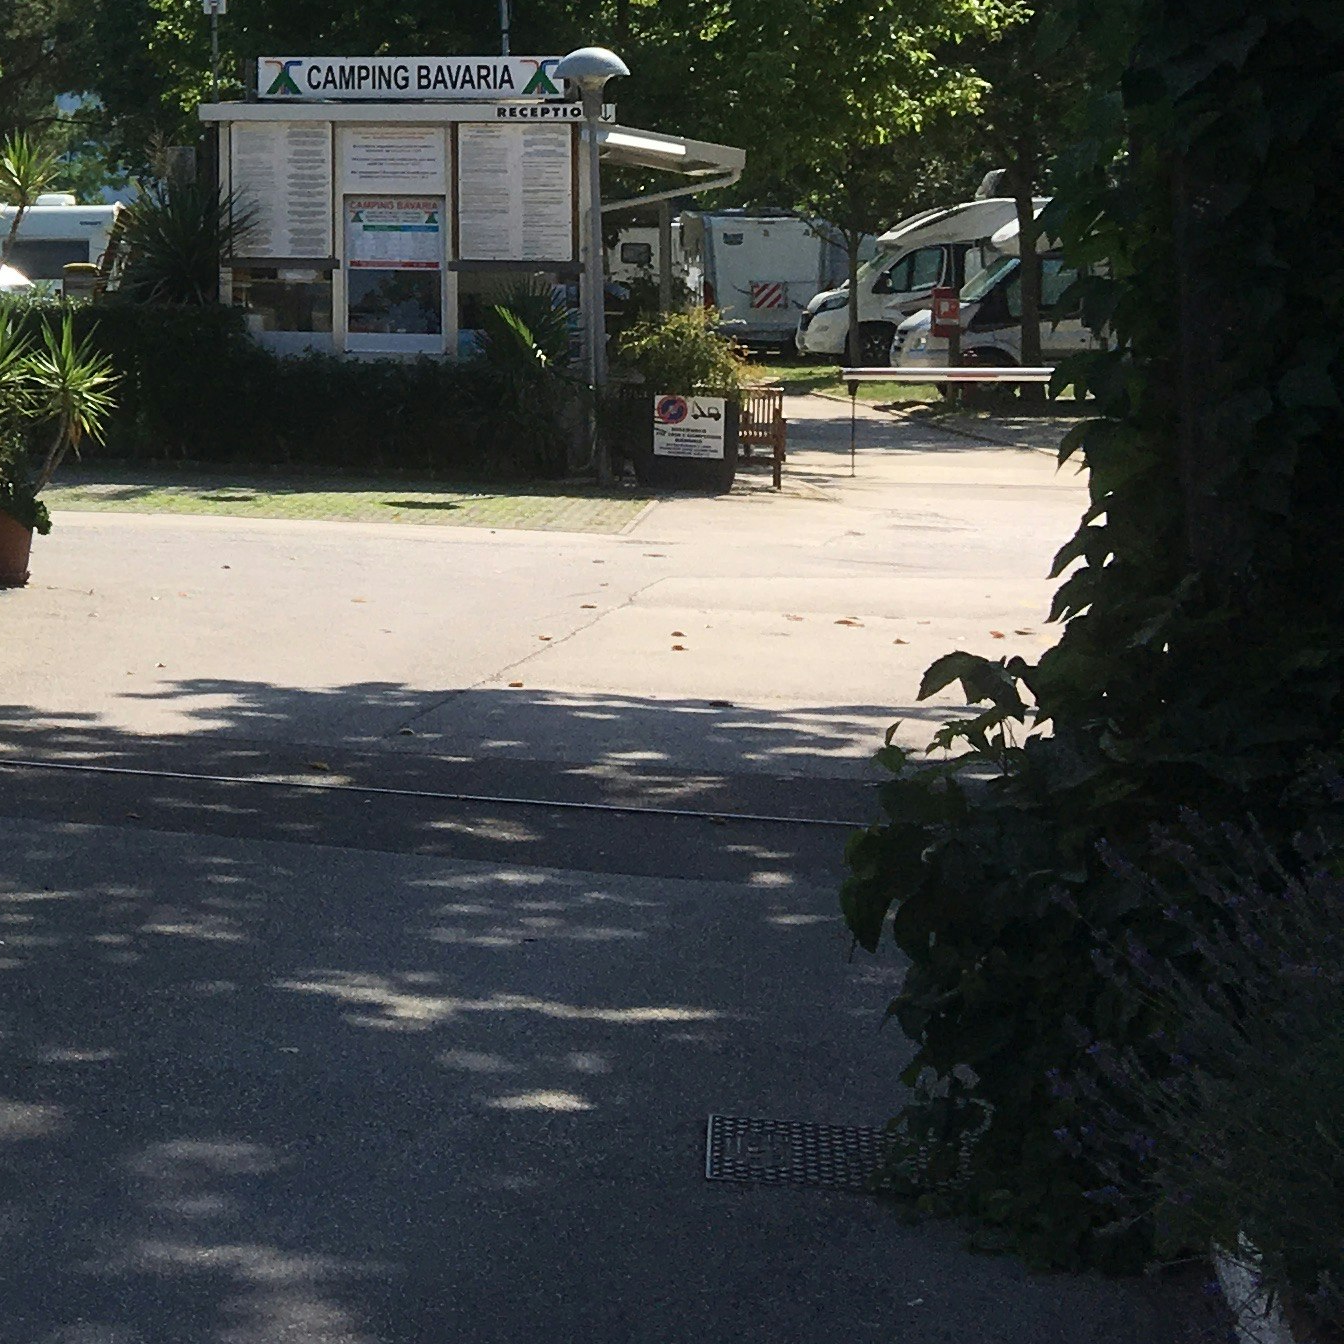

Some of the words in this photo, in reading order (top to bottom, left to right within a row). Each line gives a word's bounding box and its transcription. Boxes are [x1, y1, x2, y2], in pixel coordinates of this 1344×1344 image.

[307, 64, 409, 91] CAMPING
[417, 64, 515, 90] BAVARIA
[496, 107, 582, 118] RECEPTIO
